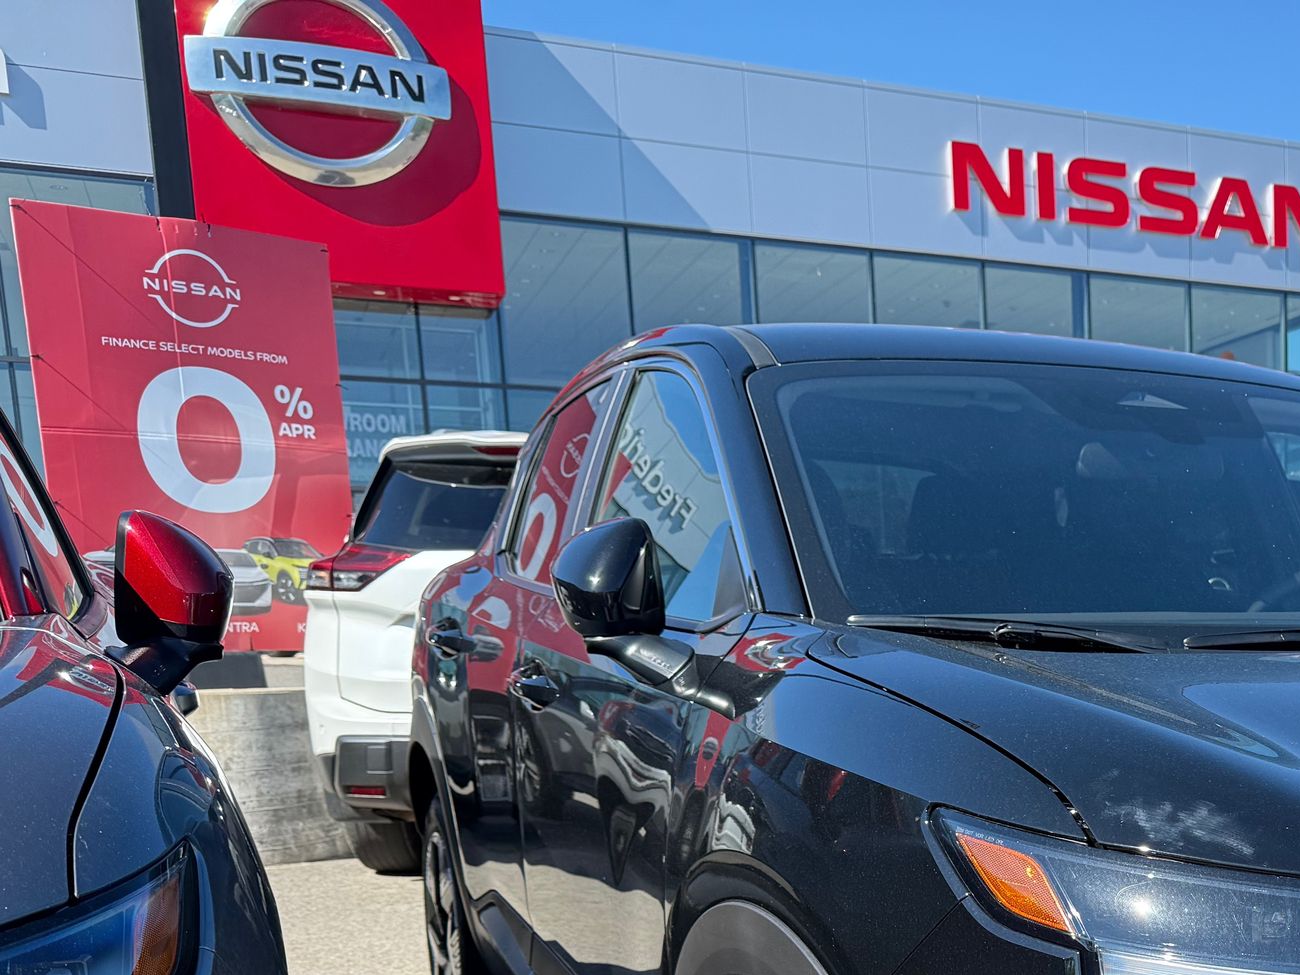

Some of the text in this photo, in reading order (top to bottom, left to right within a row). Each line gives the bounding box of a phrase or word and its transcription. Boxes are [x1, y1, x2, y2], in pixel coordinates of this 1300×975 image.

[213, 48, 426, 103] NISSAN
[142, 276, 242, 301] NISSAN
[101, 336, 288, 365] FINANCE SELECT MODELS FROM
[278, 422, 316, 440] APR
[226, 621, 260, 633] NTRA
